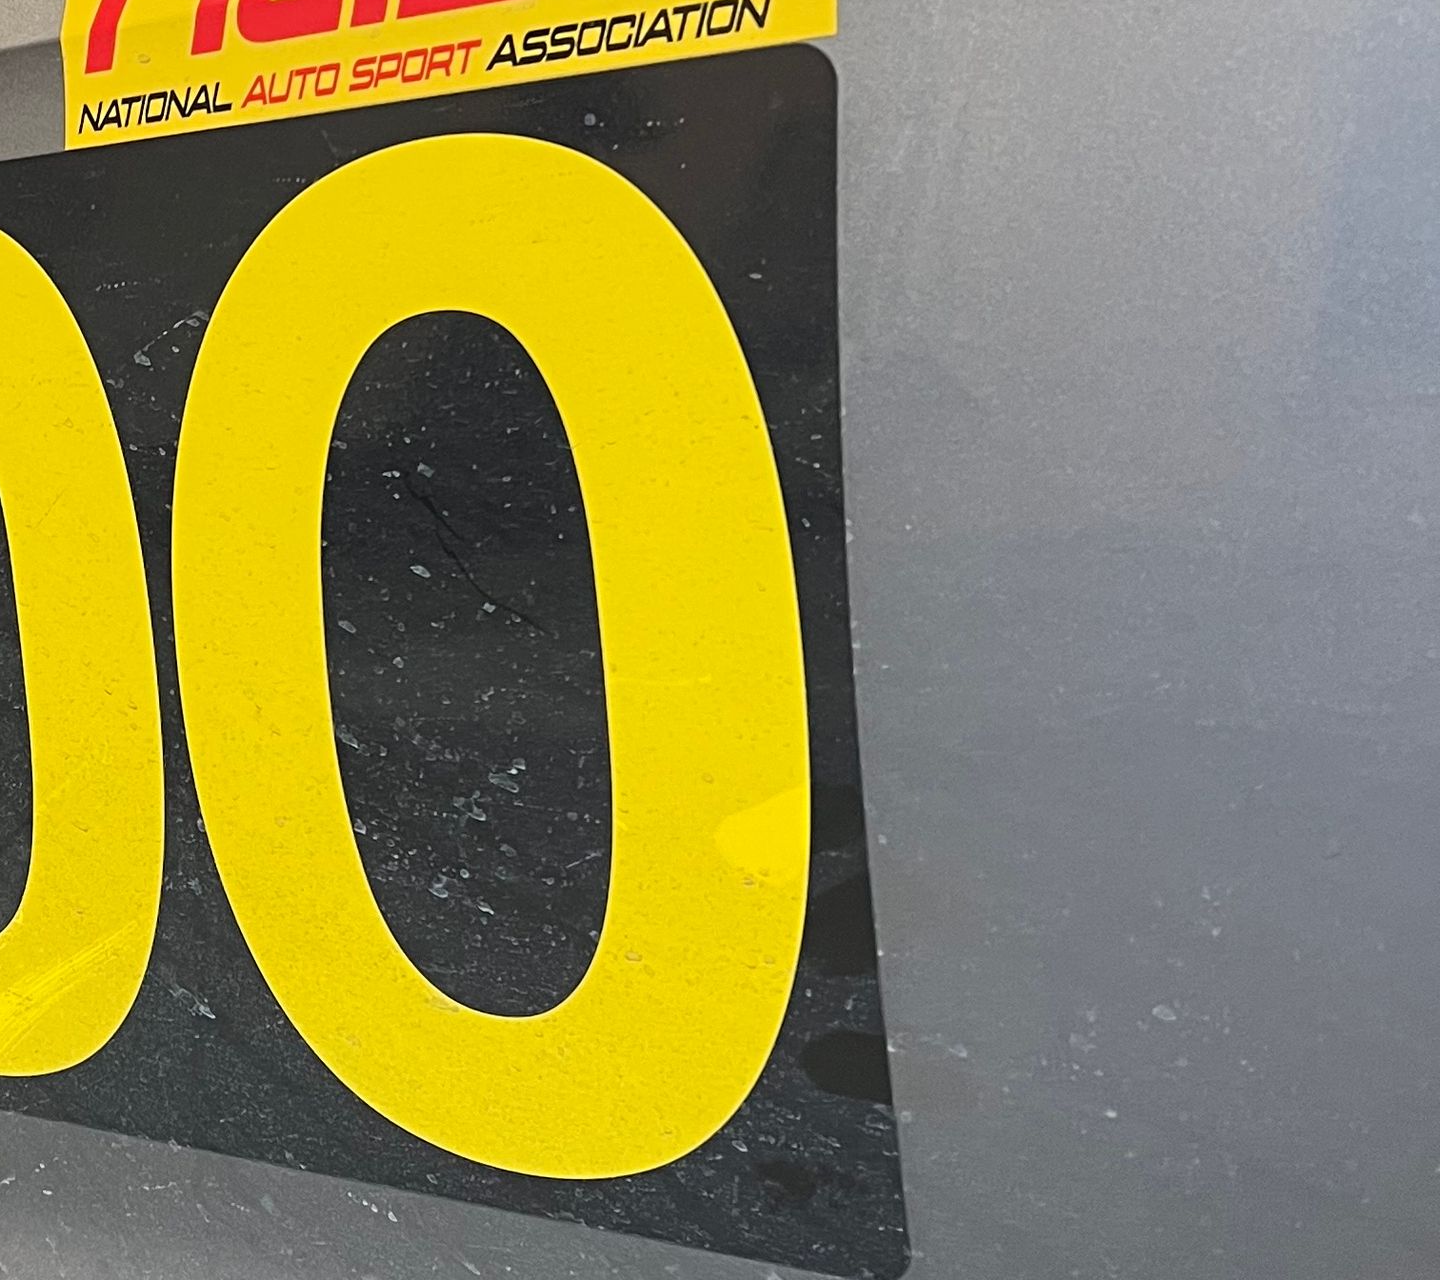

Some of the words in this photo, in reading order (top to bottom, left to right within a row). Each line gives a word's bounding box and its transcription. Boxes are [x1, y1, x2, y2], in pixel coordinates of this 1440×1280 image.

[78, 82, 233, 134] NATIONAL
[242, 62, 341, 108] AUTO
[348, 39, 483, 92] SPORT
